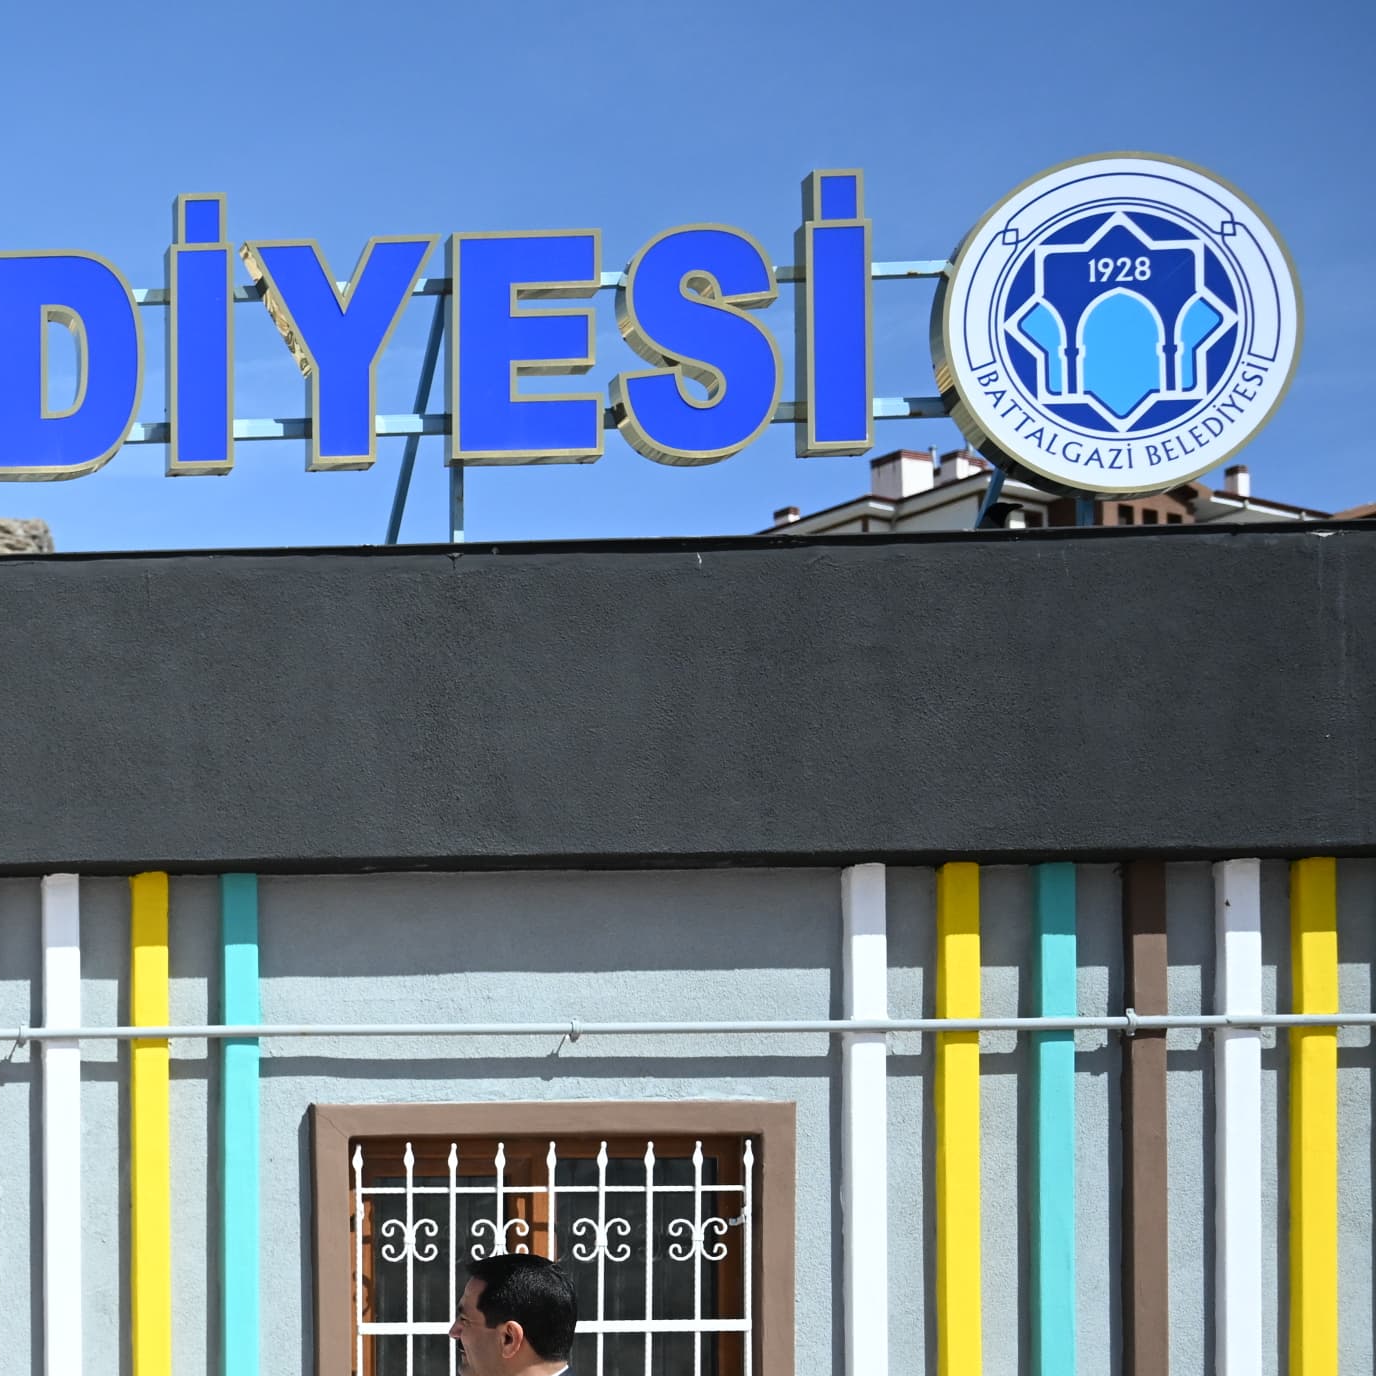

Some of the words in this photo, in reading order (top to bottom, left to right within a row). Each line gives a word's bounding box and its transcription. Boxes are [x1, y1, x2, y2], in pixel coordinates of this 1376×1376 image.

[1087, 256, 1152, 283] 1928
[977, 370, 1134, 470] BATTALGAZİ
[1144, 360, 1269, 466] BELEDİYESİ
